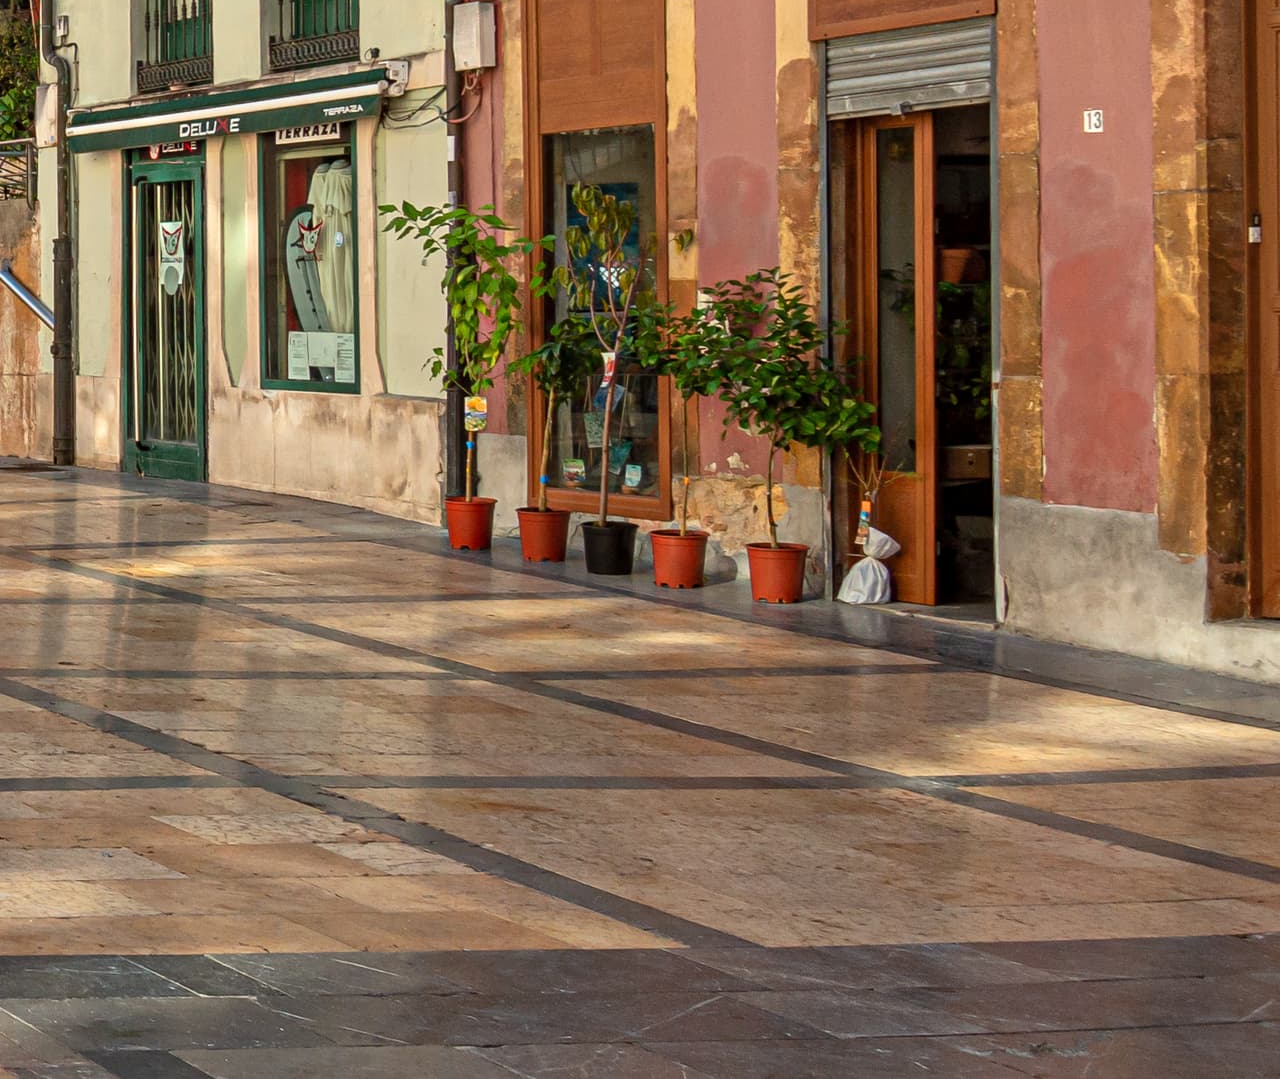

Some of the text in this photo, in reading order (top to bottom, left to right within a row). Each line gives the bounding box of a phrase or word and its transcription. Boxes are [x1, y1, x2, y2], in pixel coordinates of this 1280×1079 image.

[322, 104, 364, 117] TERRAZA
[179, 118, 240, 138] DELUXE
[1087, 111, 1102, 130] 13
[278, 123, 339, 141] TERRAZA
[161, 141, 198, 153] DELUXE
